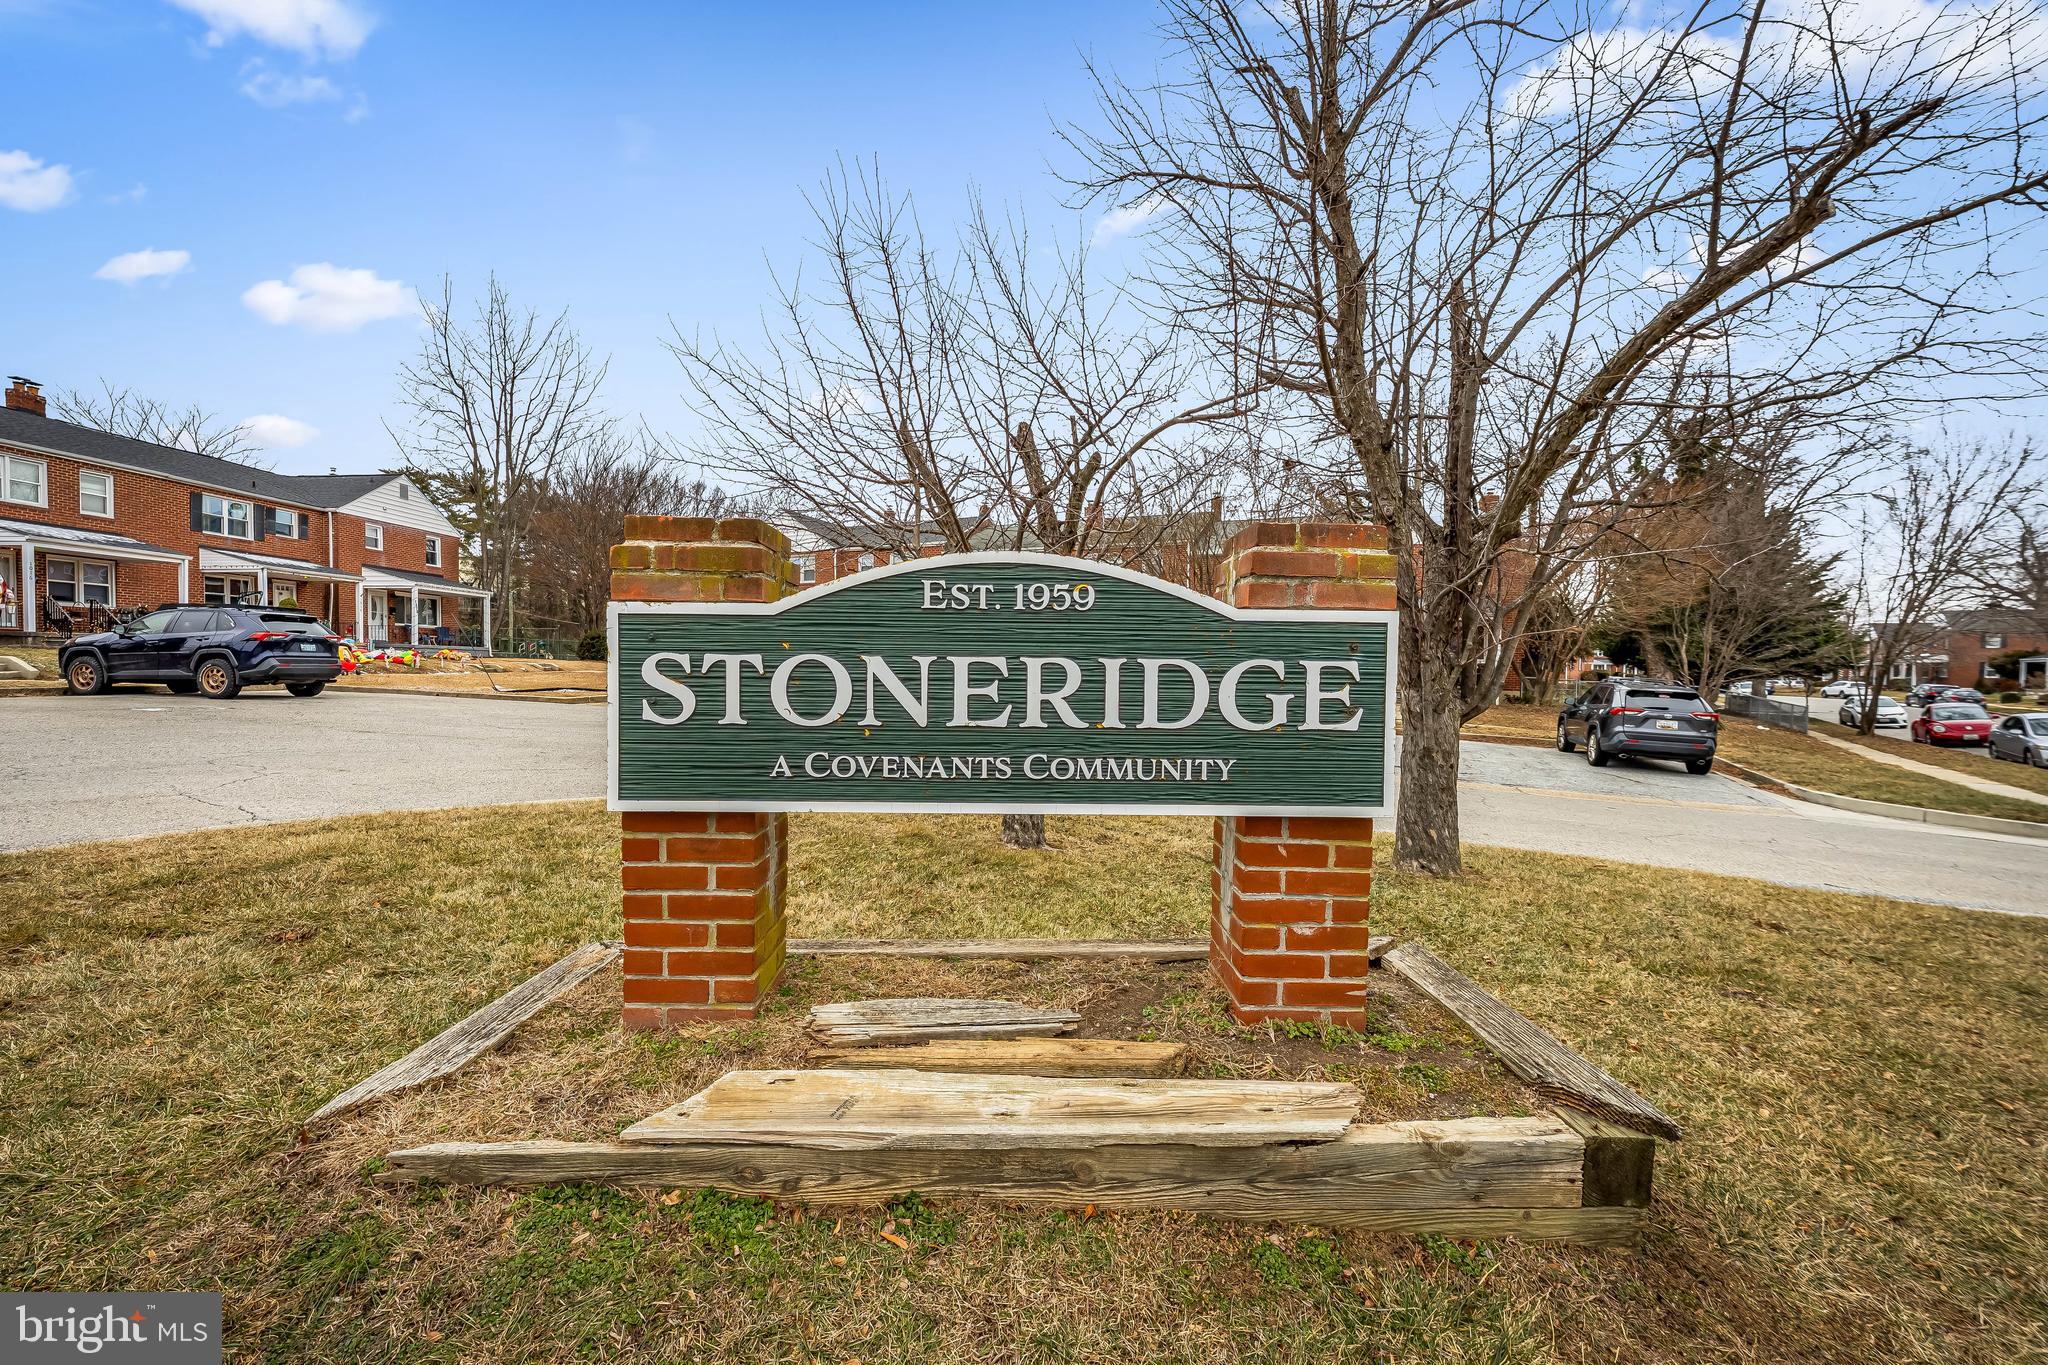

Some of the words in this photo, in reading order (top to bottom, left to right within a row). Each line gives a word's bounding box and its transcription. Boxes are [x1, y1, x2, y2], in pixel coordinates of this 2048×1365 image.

[920, 579, 1001, 610] EST.
[1013, 583, 1096, 611] 1959
[641, 651, 1363, 732] STONERIDGE
[769, 754, 793, 777] A
[804, 751, 1012, 779] COVENANTS
[1023, 753, 1237, 781] COMMUNITY
